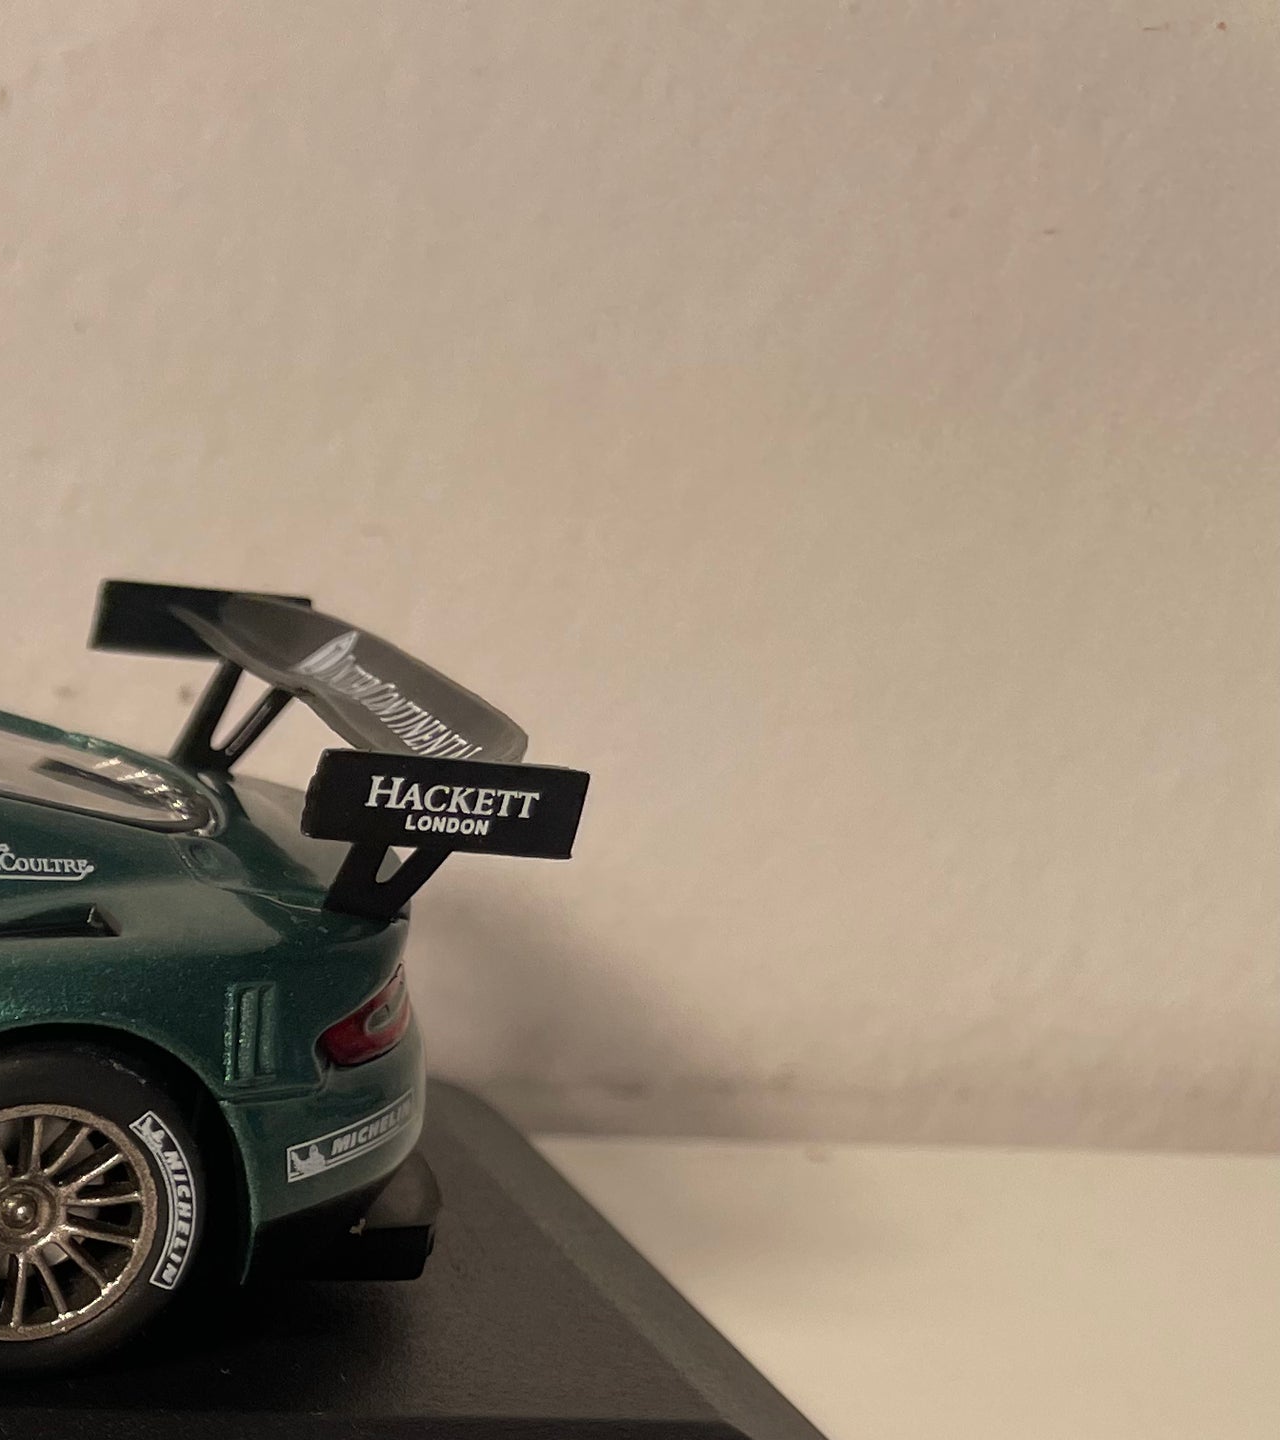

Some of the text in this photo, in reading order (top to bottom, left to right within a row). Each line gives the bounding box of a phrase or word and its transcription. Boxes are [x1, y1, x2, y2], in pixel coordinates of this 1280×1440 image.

[364, 775, 540, 818] HACKETT
[405, 814, 490, 836] LONDON
[161, 1150, 193, 1285] MICHELIN
